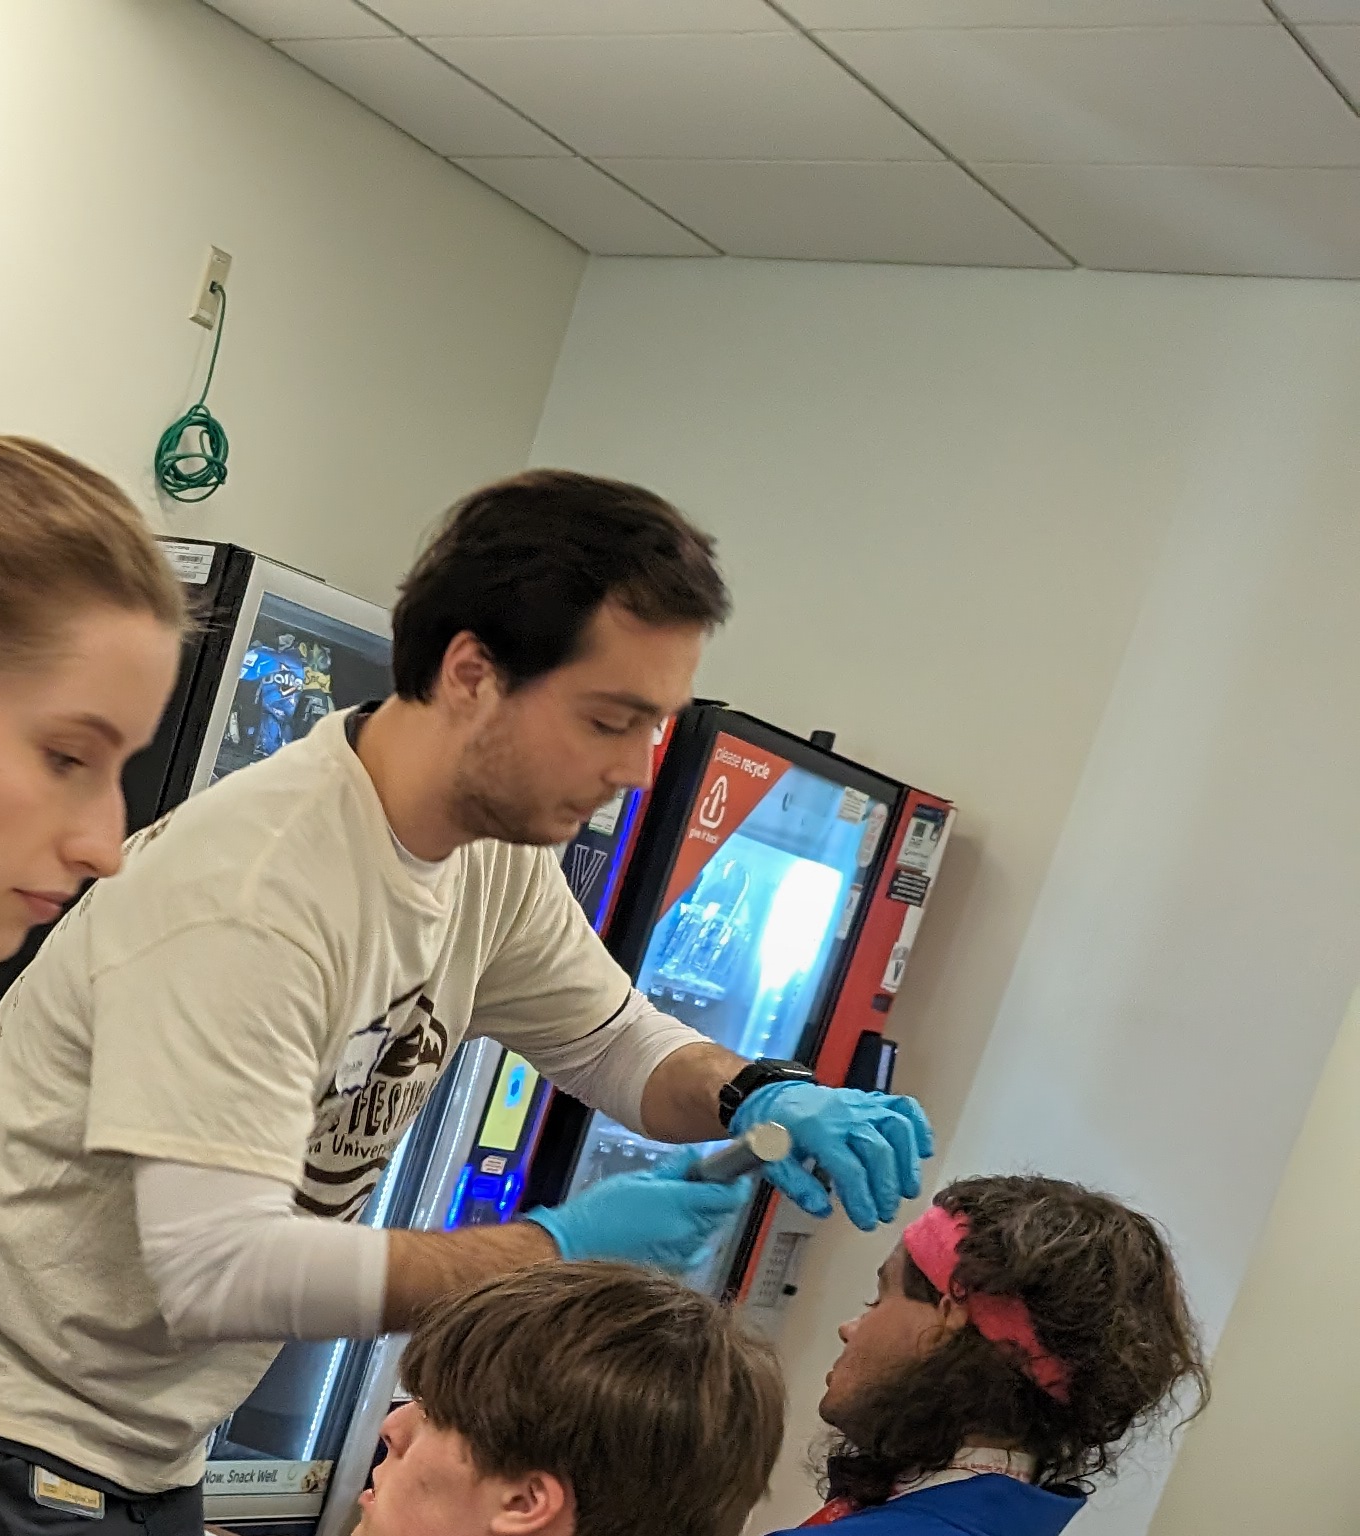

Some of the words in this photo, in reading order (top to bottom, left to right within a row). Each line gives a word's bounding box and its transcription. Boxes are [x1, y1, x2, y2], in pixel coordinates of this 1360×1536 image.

[714, 746, 742, 768] please
[740, 755, 771, 781] recycle
[226, 1469, 256, 1483] Snack
